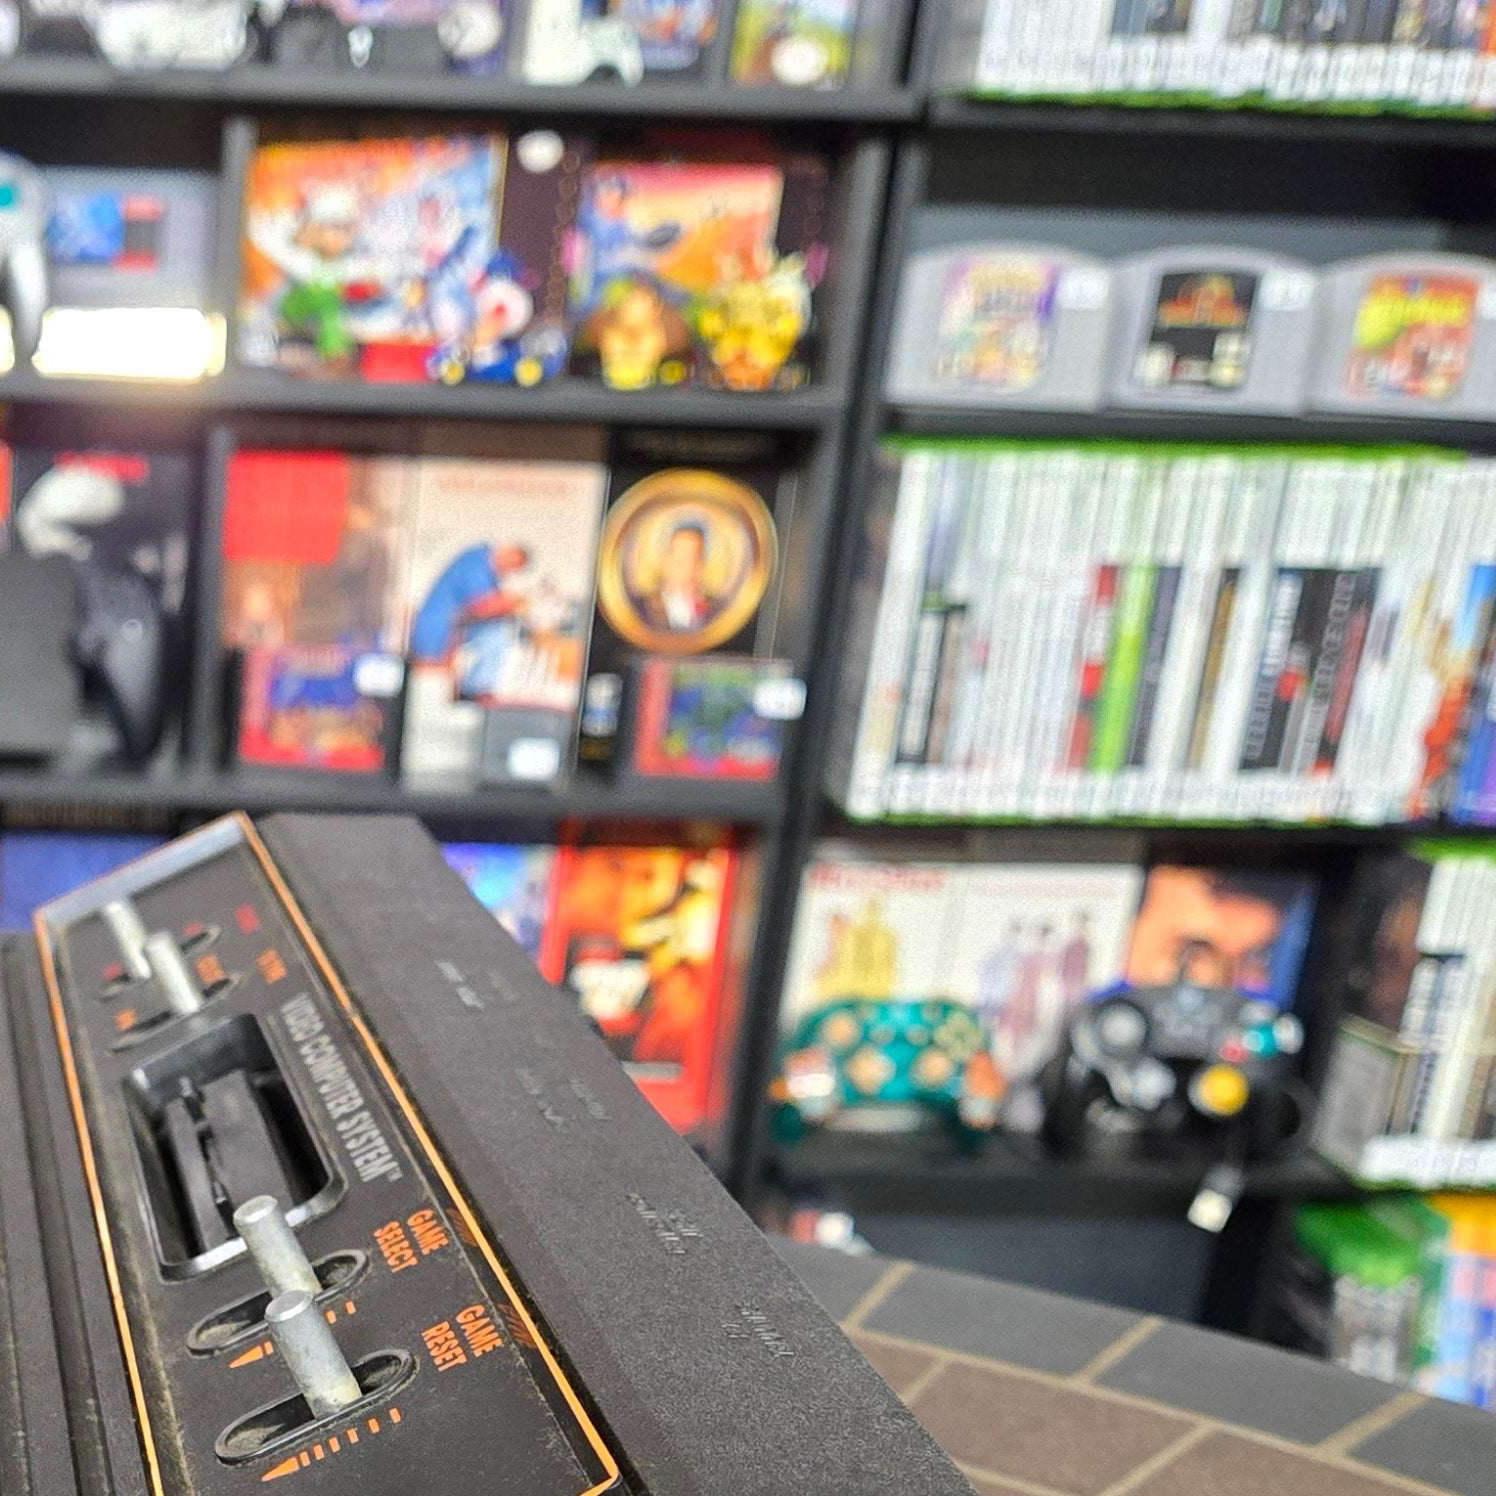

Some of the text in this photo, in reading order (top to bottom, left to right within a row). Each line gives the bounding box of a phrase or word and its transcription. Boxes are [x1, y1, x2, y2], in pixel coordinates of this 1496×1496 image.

[280, 992, 325, 1042] VIDEO
[299, 1035, 364, 1120] COMPUTER
[373, 1220, 418, 1273] SELECT
[407, 1208, 448, 1255] GAME
[421, 1320, 467, 1373] RESET
[456, 1304, 502, 1358] GAME
